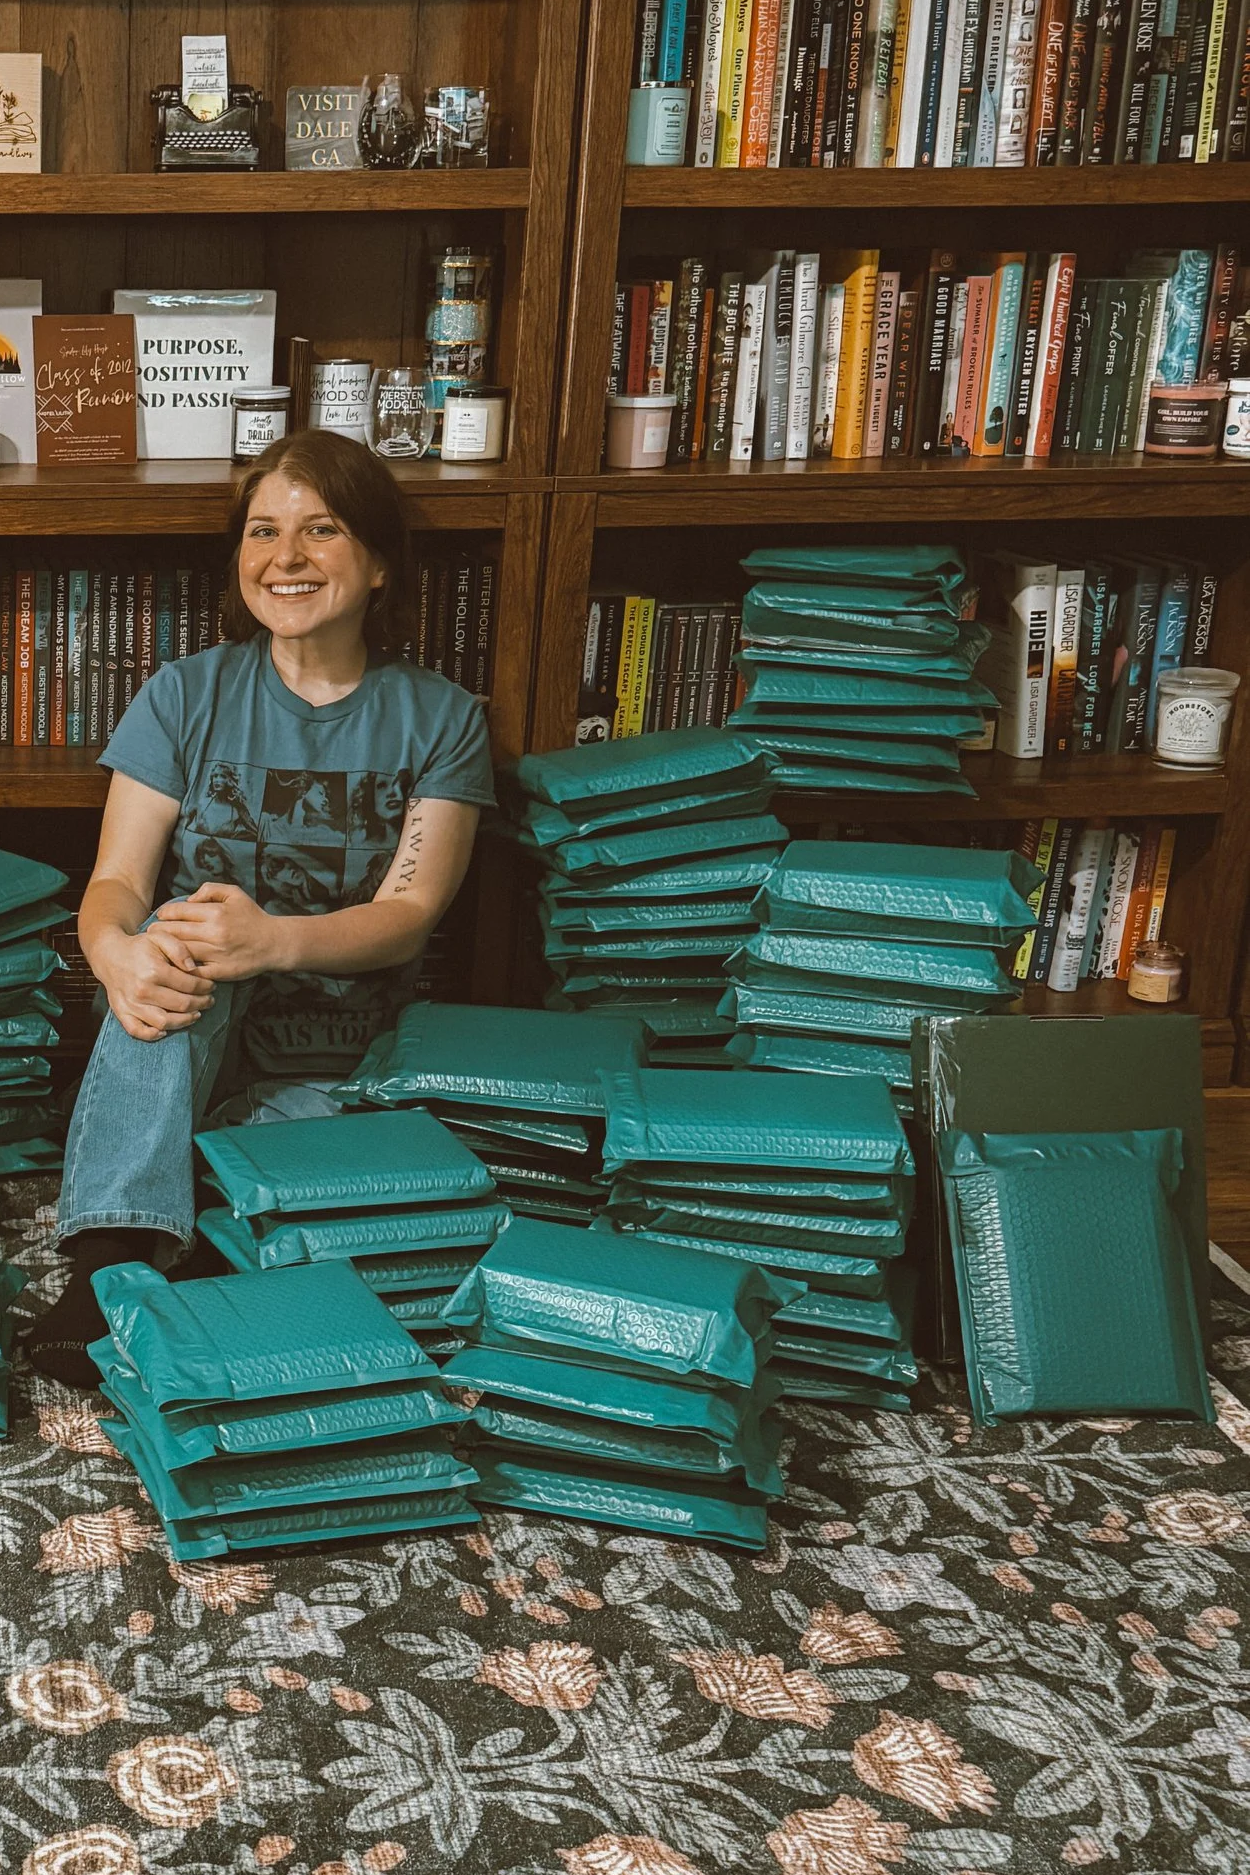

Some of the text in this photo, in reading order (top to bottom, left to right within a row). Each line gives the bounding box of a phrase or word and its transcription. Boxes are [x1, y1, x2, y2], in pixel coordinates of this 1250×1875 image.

[847, 11, 863, 90] ONE KNOWS
[876, 38, 891, 90] RETREAT
[960, 17, 979, 84] EX-HUSBAND
[987, 36, 1001, 93] GIRLFRIEND
[1136, 22, 1155, 53] ROSE
[298, 94, 358, 111] VISIT
[296, 122, 353, 139] DALE
[311, 149, 341, 166] GA
[722, 283, 740, 365] THE BOG WIFE
[777, 269, 793, 329] HEMLOCK
[860, 275, 878, 331] HIDE
[973, 298, 983, 336] SUMMER
[143, 339, 244, 358] PURPOSE,
[612, 316, 624, 371] HEATWAVE
[685, 320, 697, 371] mothers
[874, 291, 894, 380] GRACE YEAR
[896, 311, 913, 399] DEAR WIFE
[929, 287, 949, 372] GOOD MARRIAGE
[36, 356, 134, 391] Class of 2012
[1018, 329, 1037, 416] KRYSTEN RITTER
[1070, 346, 1082, 377] PRINT
[1104, 340, 1118, 376] OFFER
[75, 387, 136, 414] Reunion
[377, 400, 426, 410] MODGLIN
[380, 391, 424, 400] KIERSTEN
[247, 429, 274, 441] THRILLER
[20, 602, 31, 669] DREAM JOB
[92, 590, 100, 653] ARRANGEMENT
[108, 595, 117, 657] AMENDMENT
[125, 595, 134, 655] ATONEMENT
[141, 600, 151, 667] ROOMMATE
[454, 598, 468, 653] HOLLOW
[1029, 610, 1048, 652] HIDE
[1060, 606, 1077, 653] GARDNER
[1194, 601, 1211, 656] JACKSON
[1168, 703, 1215, 718] MOONSTONE
[393, 798, 425, 894] ALWAYS
[1111, 857, 1132, 928] SNOW ROSE
